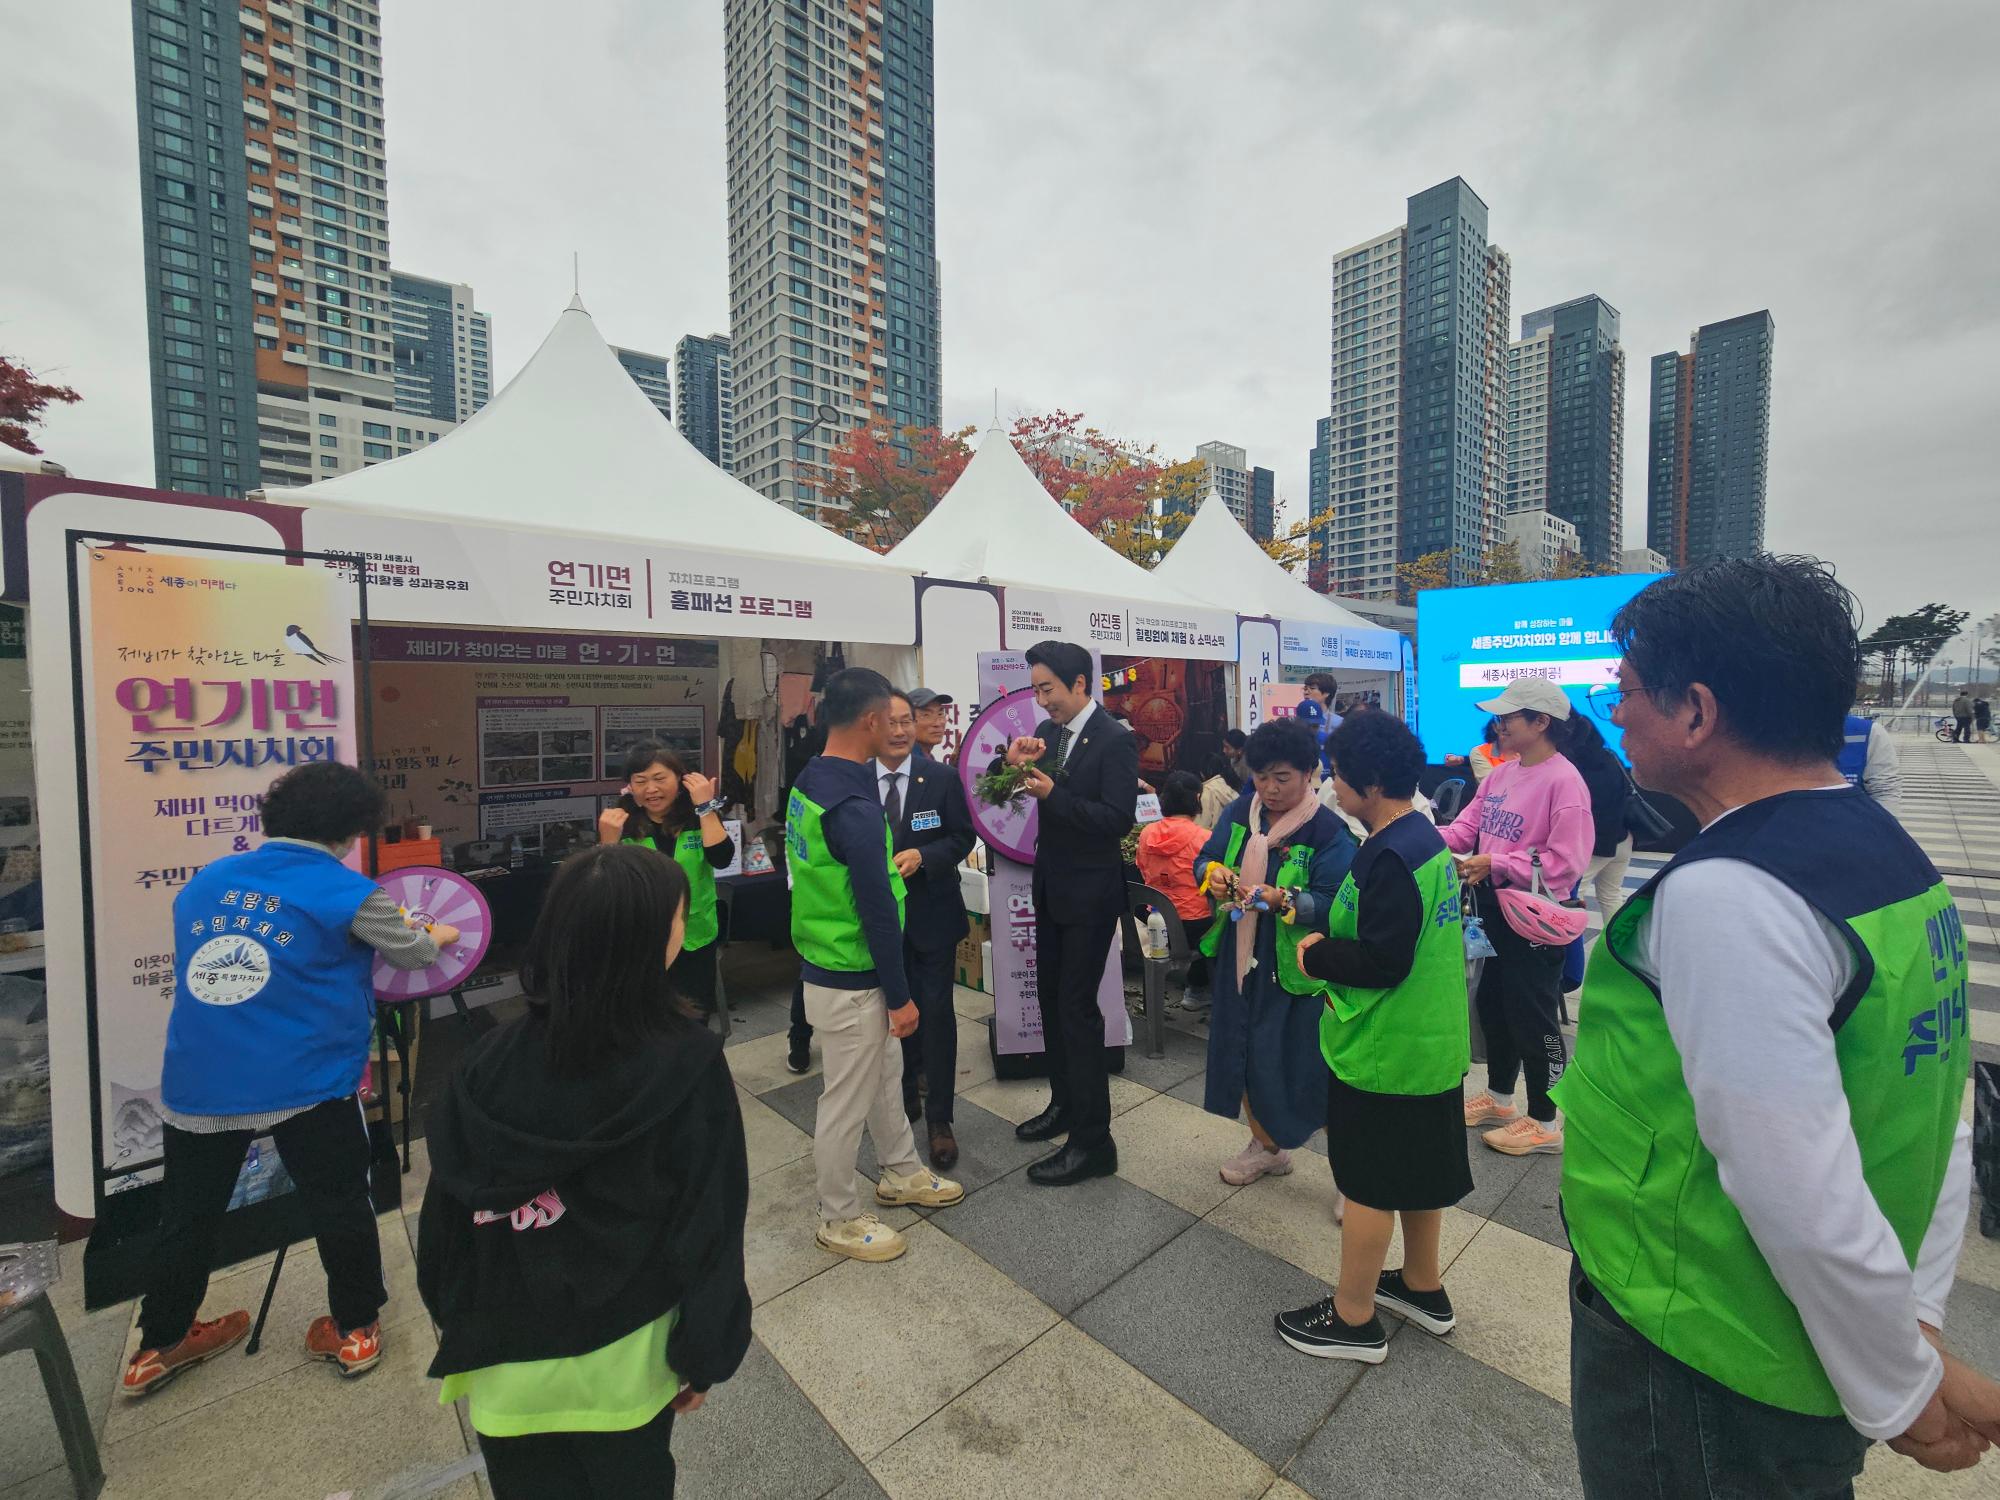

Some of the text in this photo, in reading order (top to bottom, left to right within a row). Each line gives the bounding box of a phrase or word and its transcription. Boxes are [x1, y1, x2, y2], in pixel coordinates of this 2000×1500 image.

[384, 554, 412, 563] 세종시
[382, 563, 420, 576] 박람회
[548, 560, 740, 591] 연기면 자치프로그램
[160, 576, 239, 591] 세종이 미래다
[408, 577, 469, 591] 성과공유회
[549, 589, 812, 619] 주민자치회 홈패션 프로그램
[1090, 612, 1120, 630] 어진동
[118, 647, 285, 667] 제비가 찾아오는 마을
[406, 640, 461, 656] 제비가
[465, 642, 531, 659] 찾아오는
[536, 645, 568, 660] 마을
[115, 677, 337, 732] 연기면
[124, 736, 335, 773] 주민자치회
[153, 797, 205, 817] 제비
[233, 835, 250, 852] &
[220, 890, 280, 913] 보람동
[191, 916, 293, 946] 주민자치회
[134, 952, 174, 970] 이웃이
[133, 970, 174, 987] 마을공
[1543, 1034, 1564, 1089] IKE AIR
